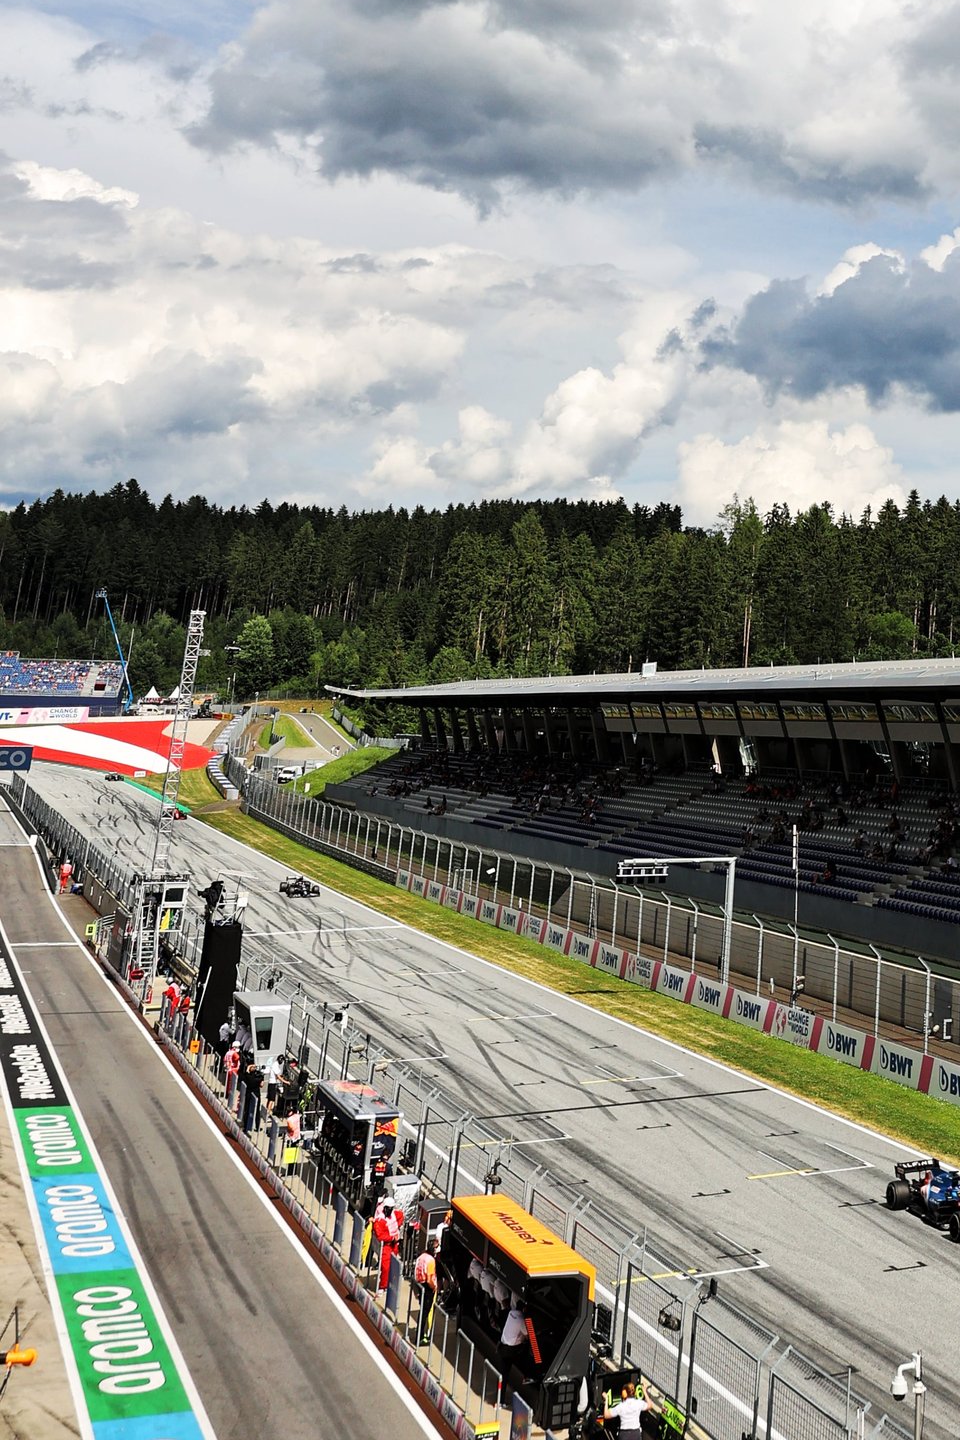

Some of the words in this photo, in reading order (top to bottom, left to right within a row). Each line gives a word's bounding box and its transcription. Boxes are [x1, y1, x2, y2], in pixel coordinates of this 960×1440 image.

[577, 941, 590, 958] BWT
[605, 951, 618, 969] BWT
[668, 973, 684, 993] BWT
[704, 986, 721, 1007] BWT
[743, 1000, 761, 1022] BWT
[788, 1010, 809, 1026] CHANGE
[791, 1024, 809, 1037] WORLD
[835, 1034, 857, 1058] BWT
[889, 1052, 913, 1078] BWT
[24, 1114, 83, 1167] aramco
[44, 1184, 116, 1257] aramco
[492, 1210, 538, 1244] McLaren
[72, 1285, 167, 1395] aramco
